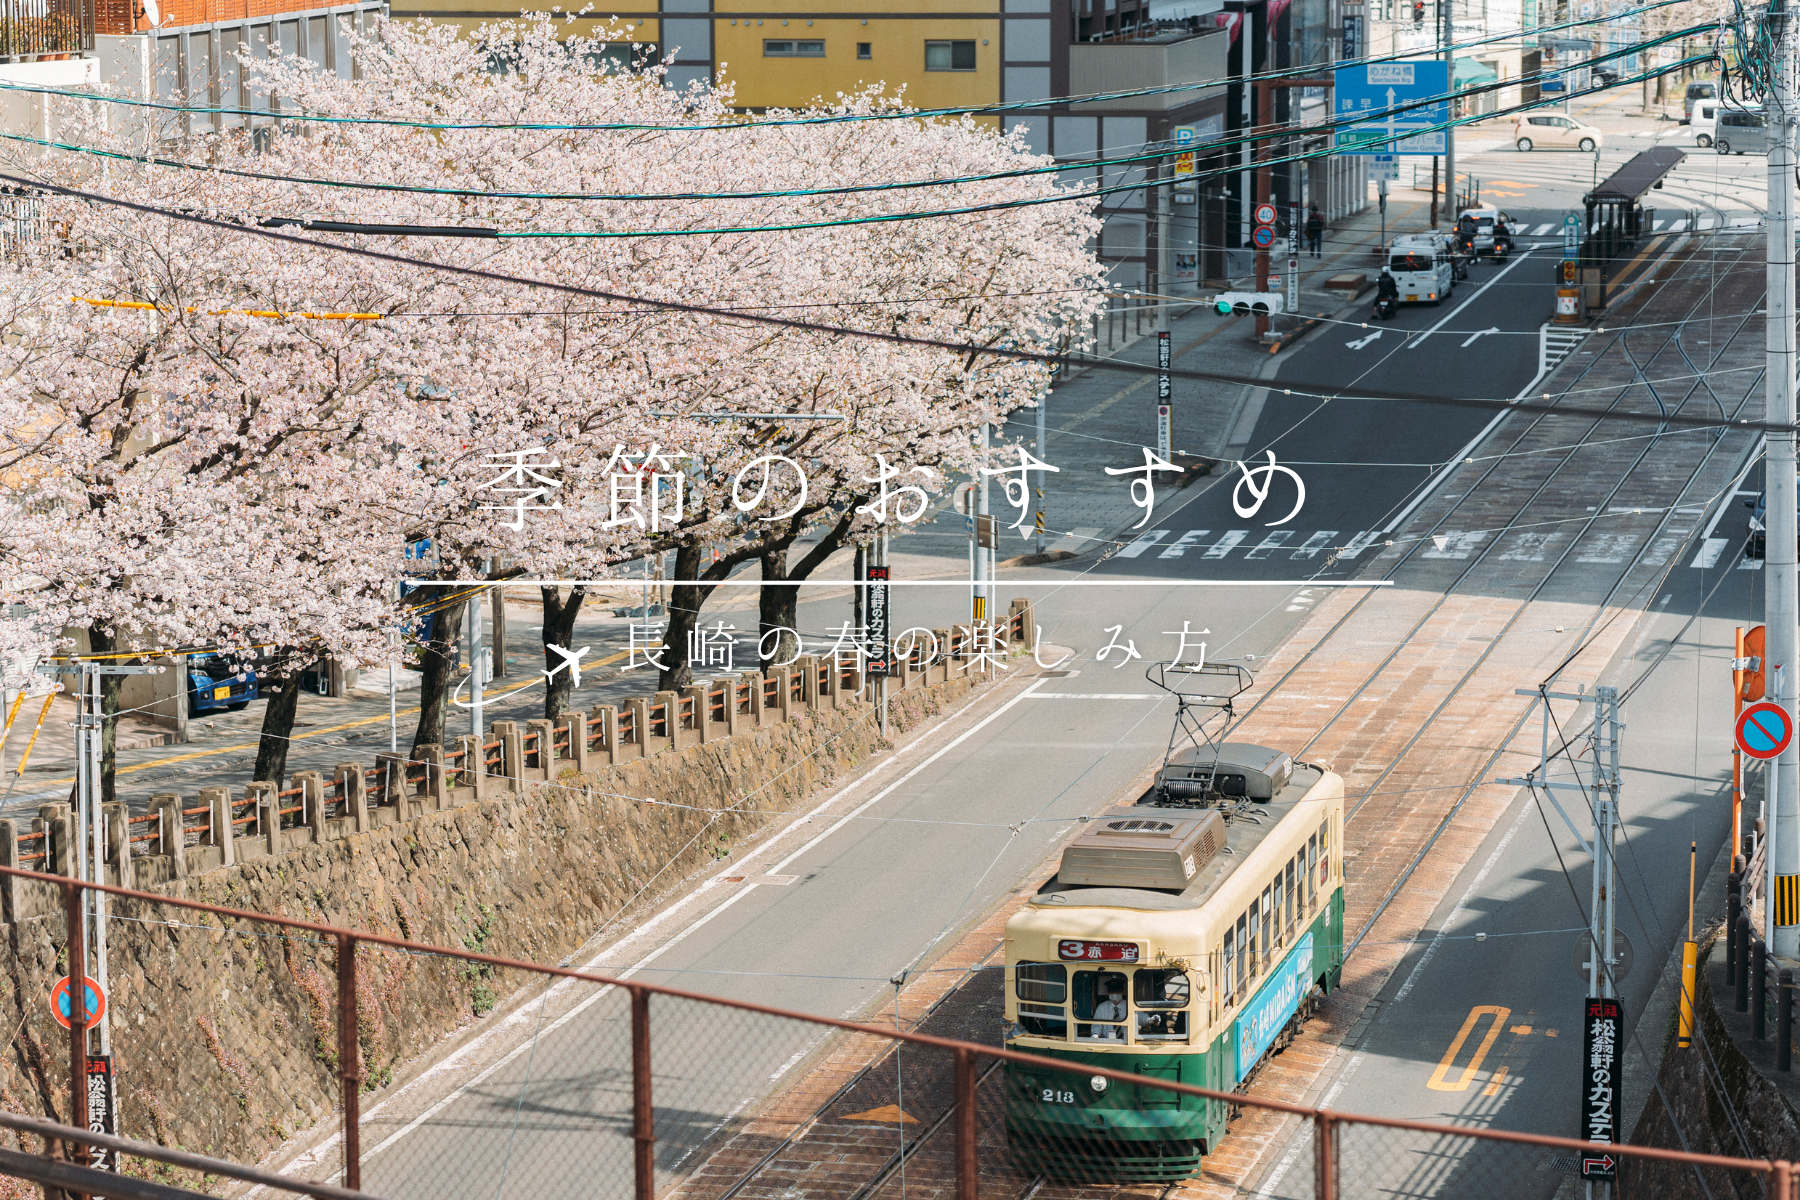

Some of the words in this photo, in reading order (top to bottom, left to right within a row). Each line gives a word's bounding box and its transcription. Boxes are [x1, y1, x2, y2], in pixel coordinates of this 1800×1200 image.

[1369, 66, 1412, 76] めがね橋
[1342, 99, 1371, 111] 諫早
[1259, 209, 1273, 220] 40
[1159, 338, 1170, 397] 松翁軒のステラ
[1060, 941, 1085, 957] 3
[1088, 945, 1138, 960] 赤迫
[1588, 1004, 1618, 1017] 元祖
[1042, 1089, 1075, 1104] 213
